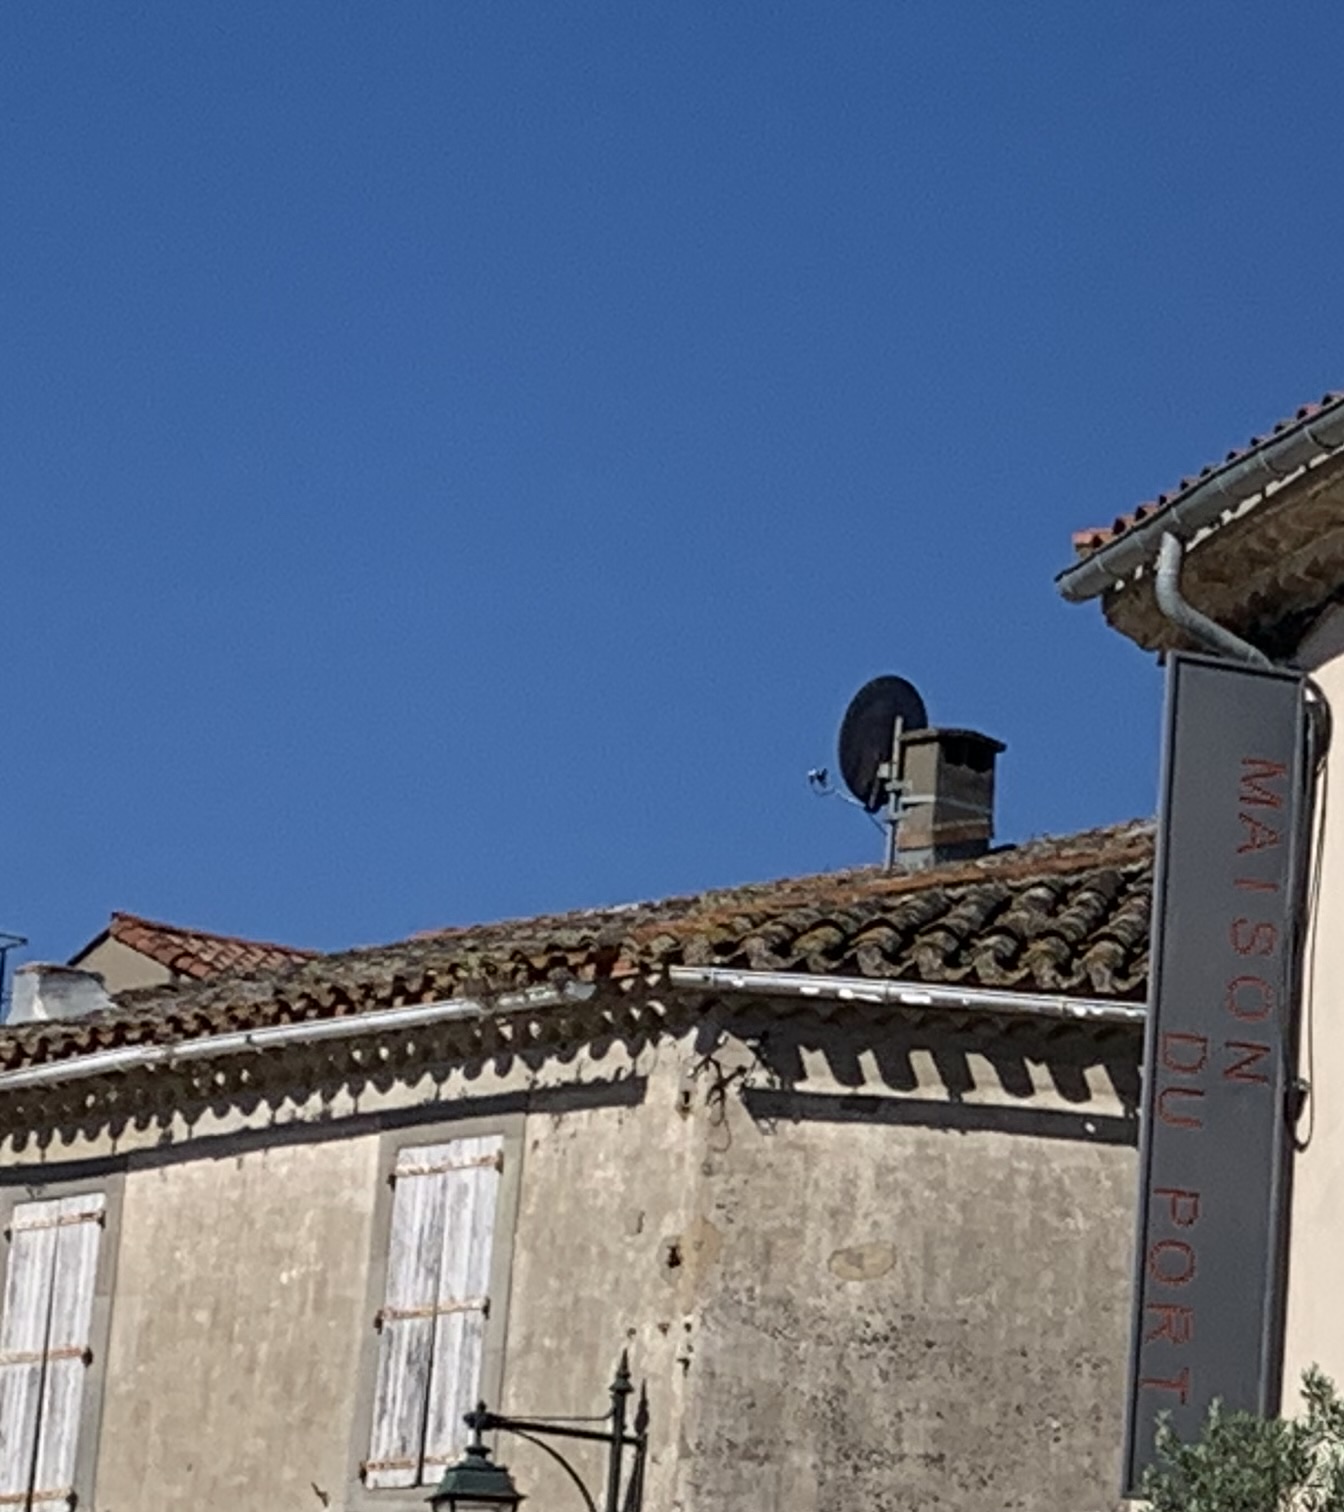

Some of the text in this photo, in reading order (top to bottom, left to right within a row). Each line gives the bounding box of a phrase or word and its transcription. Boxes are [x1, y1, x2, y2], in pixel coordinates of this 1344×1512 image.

[1223, 757, 1287, 1085] MAISON
[1139, 1031, 1209, 1406] DU PORT
